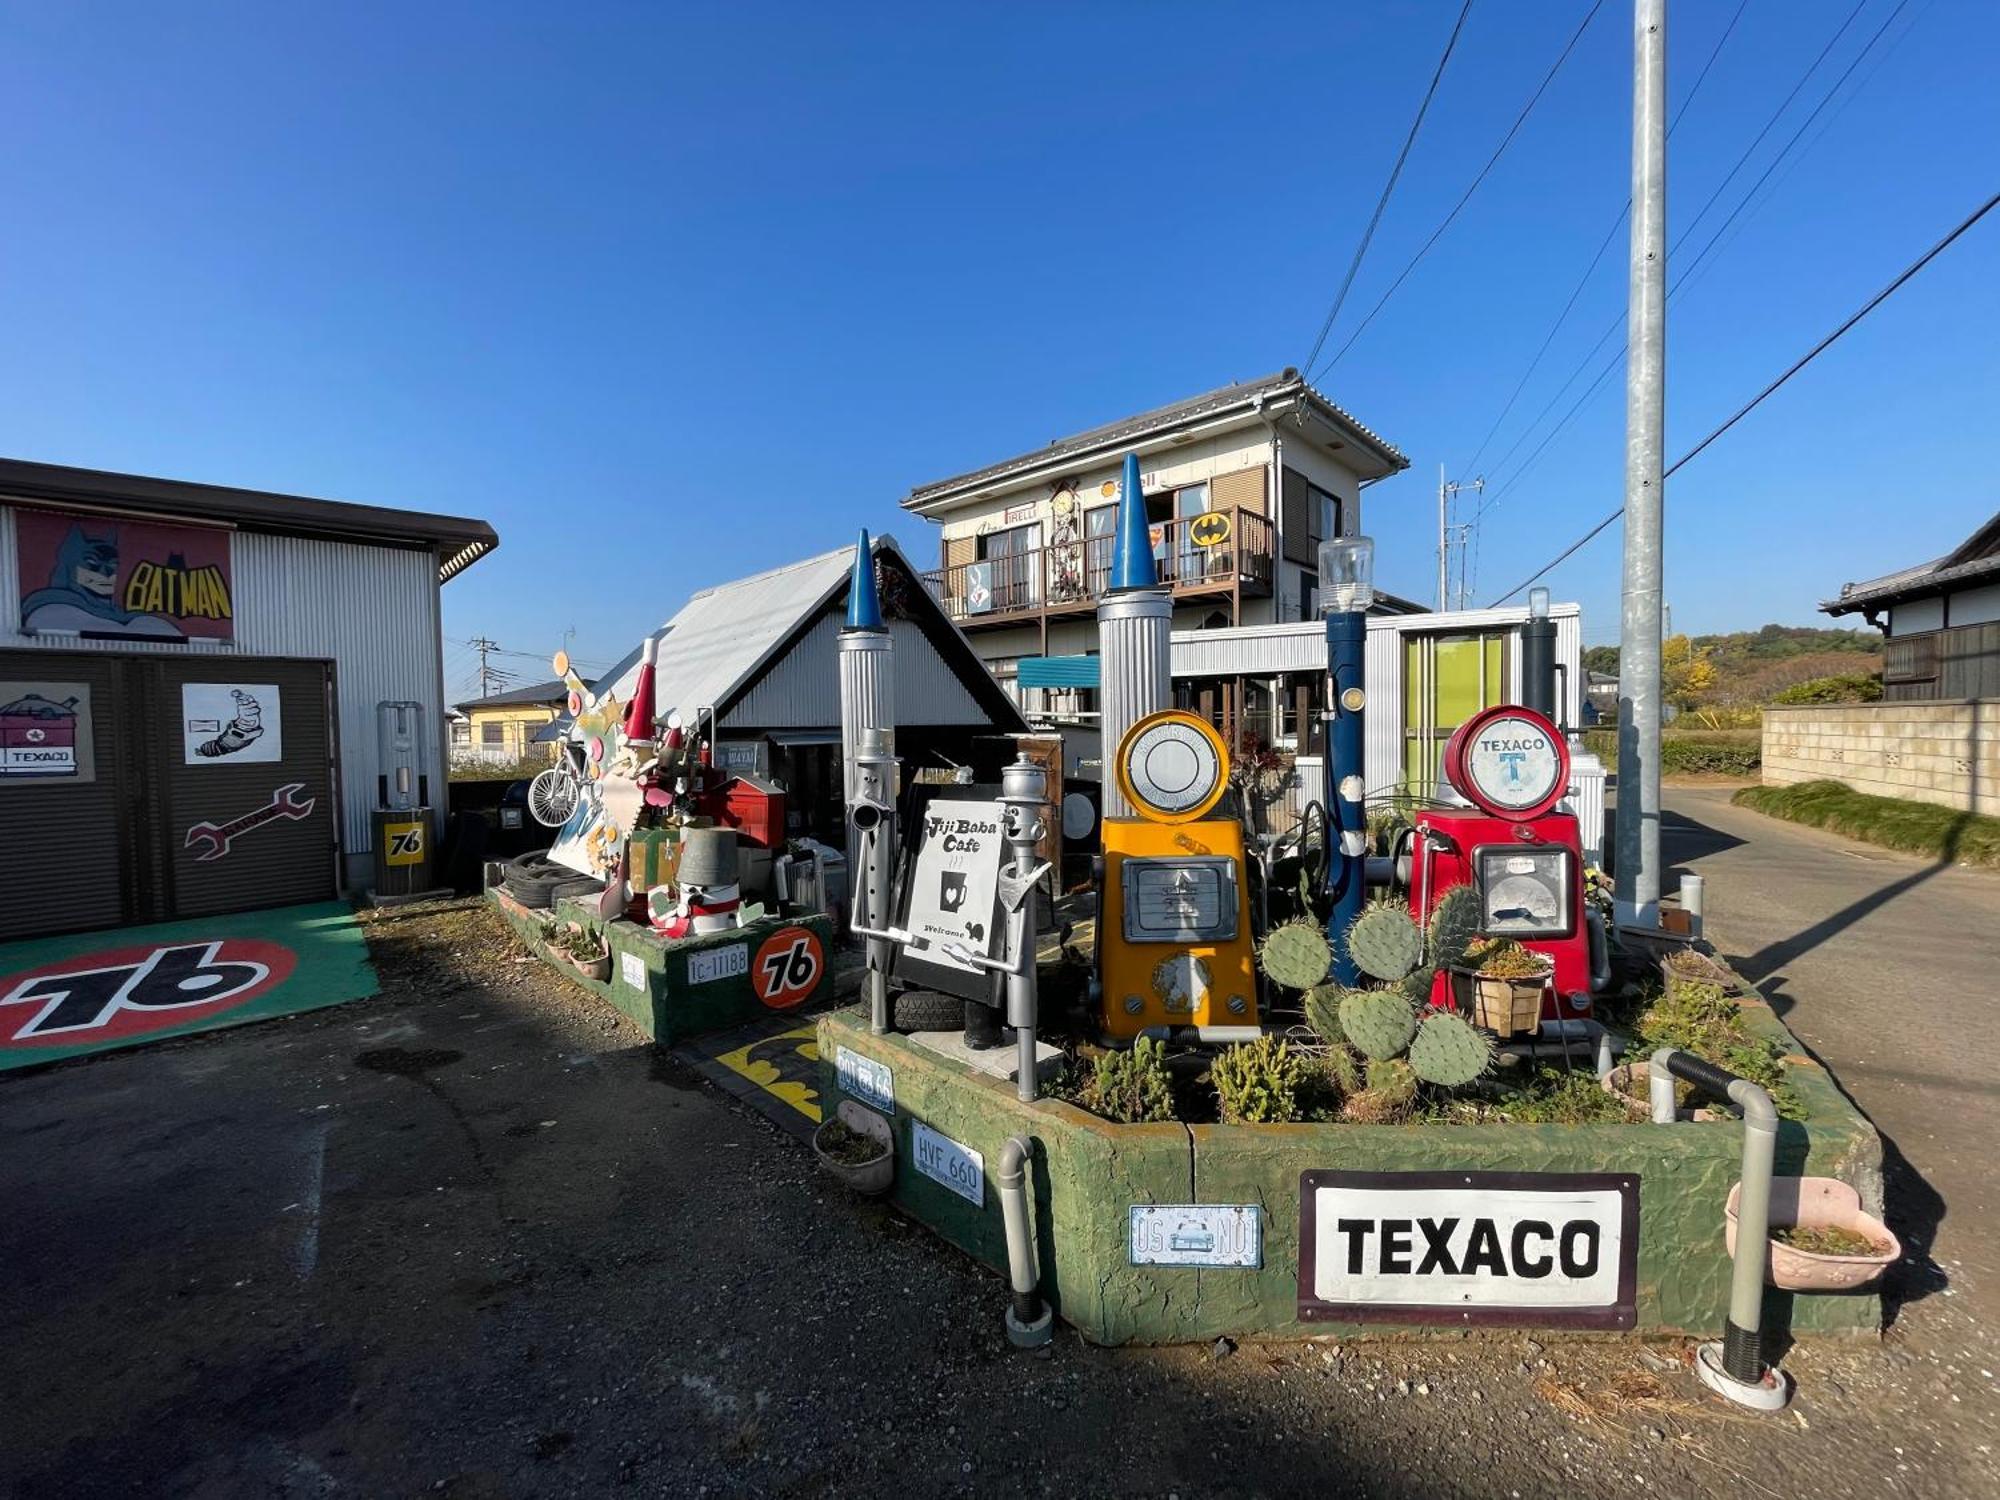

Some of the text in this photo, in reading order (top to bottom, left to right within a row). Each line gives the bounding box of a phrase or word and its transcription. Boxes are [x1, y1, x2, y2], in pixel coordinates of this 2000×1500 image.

[1004, 500, 1037, 525] PIRELLI
[126, 562, 232, 618] BATMAN
[12, 751, 70, 762] TEXACO
[1481, 738, 1545, 752] TEXACO
[927, 816, 997, 838] Jiji Baba
[390, 829, 421, 857] 76
[943, 834, 981, 852] Cafe
[924, 924, 964, 939] Welcome
[763, 938, 816, 997] 76
[0, 941, 270, 1040] 76
[919, 1137, 943, 1170] HVF
[949, 1155, 977, 1189] 660
[1136, 1217, 1164, 1253] US
[1338, 1218, 1601, 1279] TEXACO
